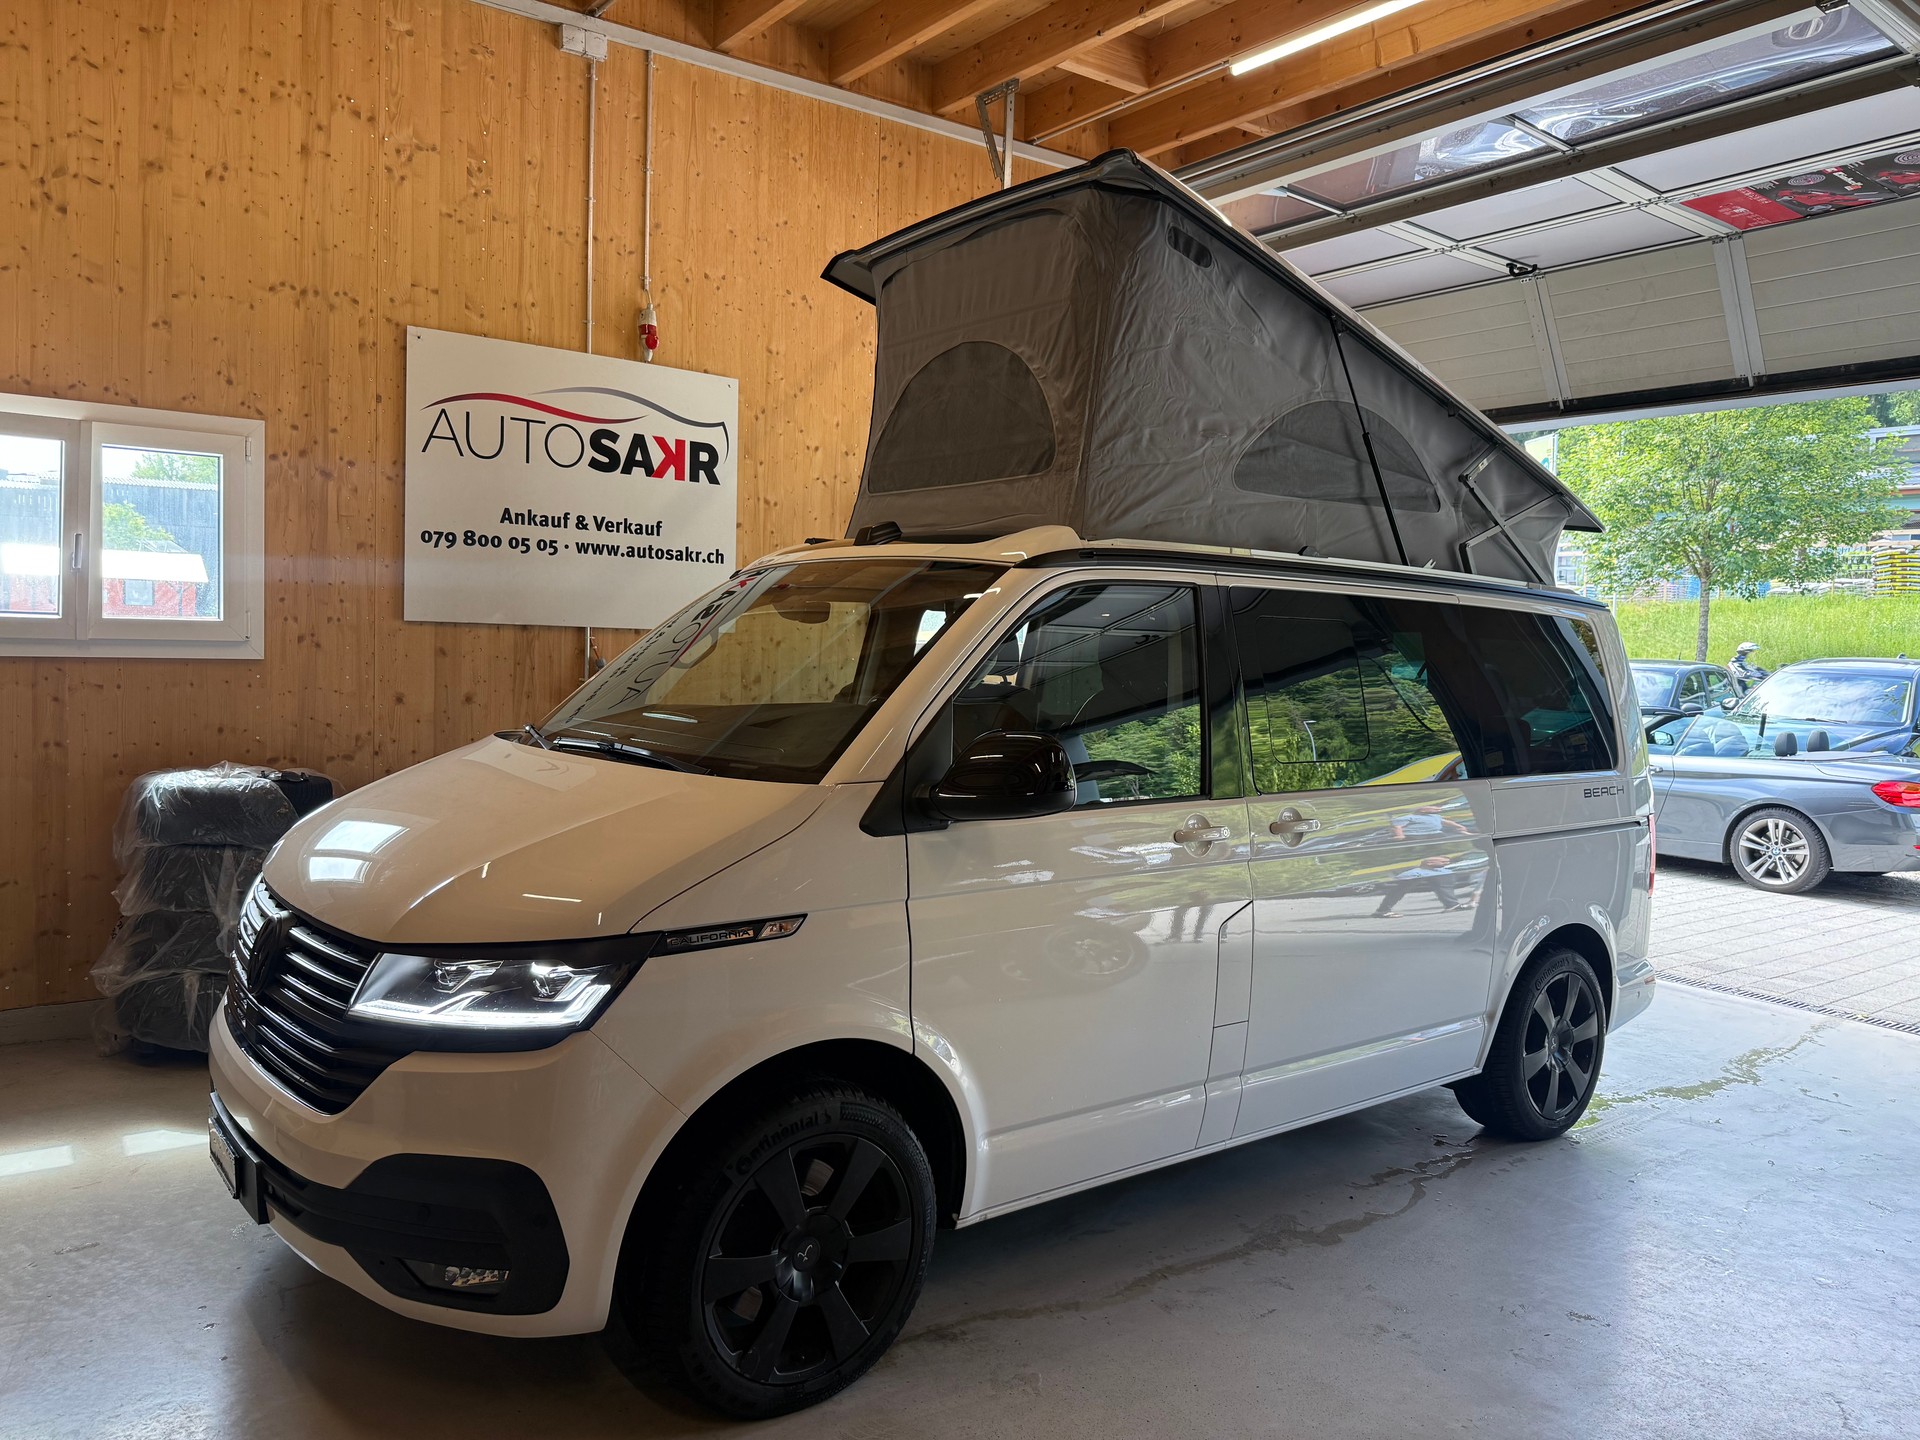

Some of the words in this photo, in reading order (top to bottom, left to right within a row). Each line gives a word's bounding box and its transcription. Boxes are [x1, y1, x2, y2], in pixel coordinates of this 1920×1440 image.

[500, 508, 570, 529] Ankauf
[575, 514, 589, 530] &
[593, 515, 663, 537] Verkauf
[420, 530, 457, 549] 079
[463, 530, 502, 549] 800
[509, 536, 530, 555] 05
[537, 538, 558, 556] 05
[576, 541, 725, 565] www.autosakr.ch
[1584, 785, 1624, 798] BEACH
[670, 929, 750, 946] CALIFORNIA
[1535, 958, 1566, 990] Continental
[736, 1112, 818, 1174] Continental
